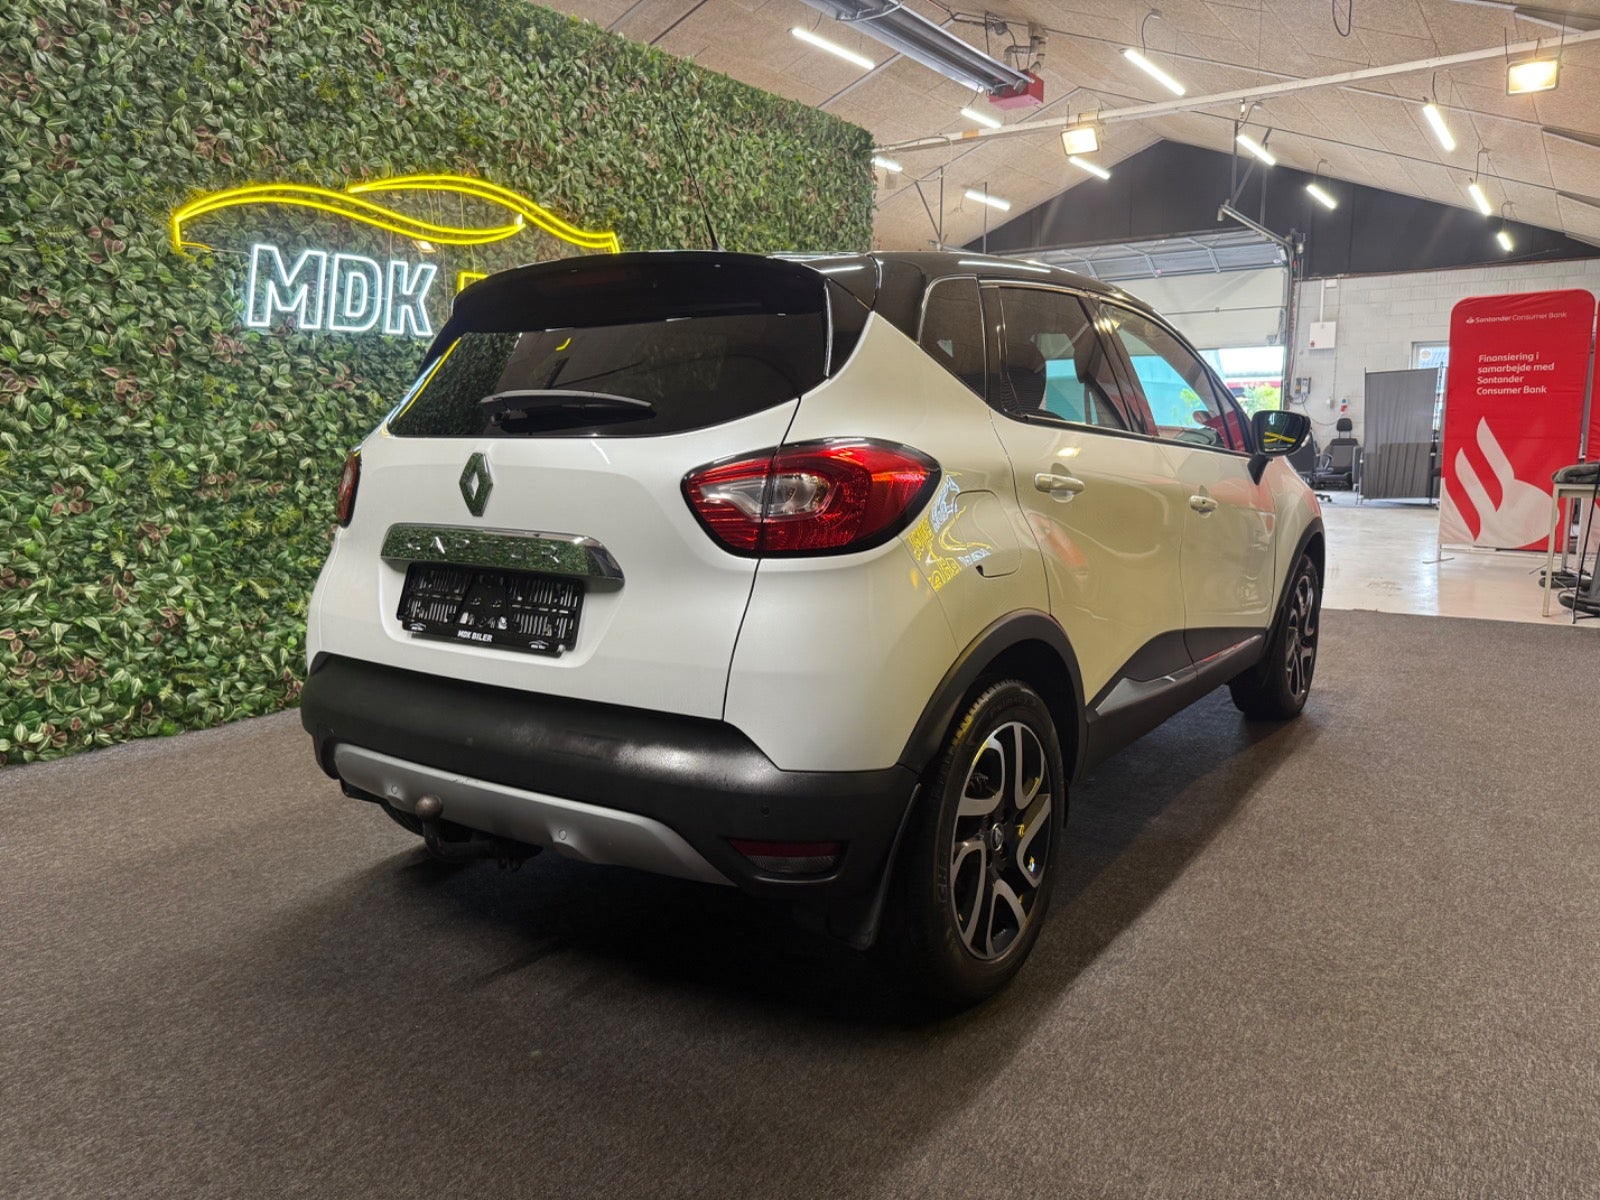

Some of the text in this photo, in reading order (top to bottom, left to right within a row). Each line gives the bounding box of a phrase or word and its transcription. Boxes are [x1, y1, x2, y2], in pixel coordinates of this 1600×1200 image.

[246, 243, 438, 337] MDK
[1512, 313, 1547, 321] Consumer
[1478, 352, 1534, 363] Finansiering
[1477, 362, 1555, 375] samarbejde med
[1477, 375, 1524, 385] Santander
[1476, 385, 1547, 396] Consumer Bank
